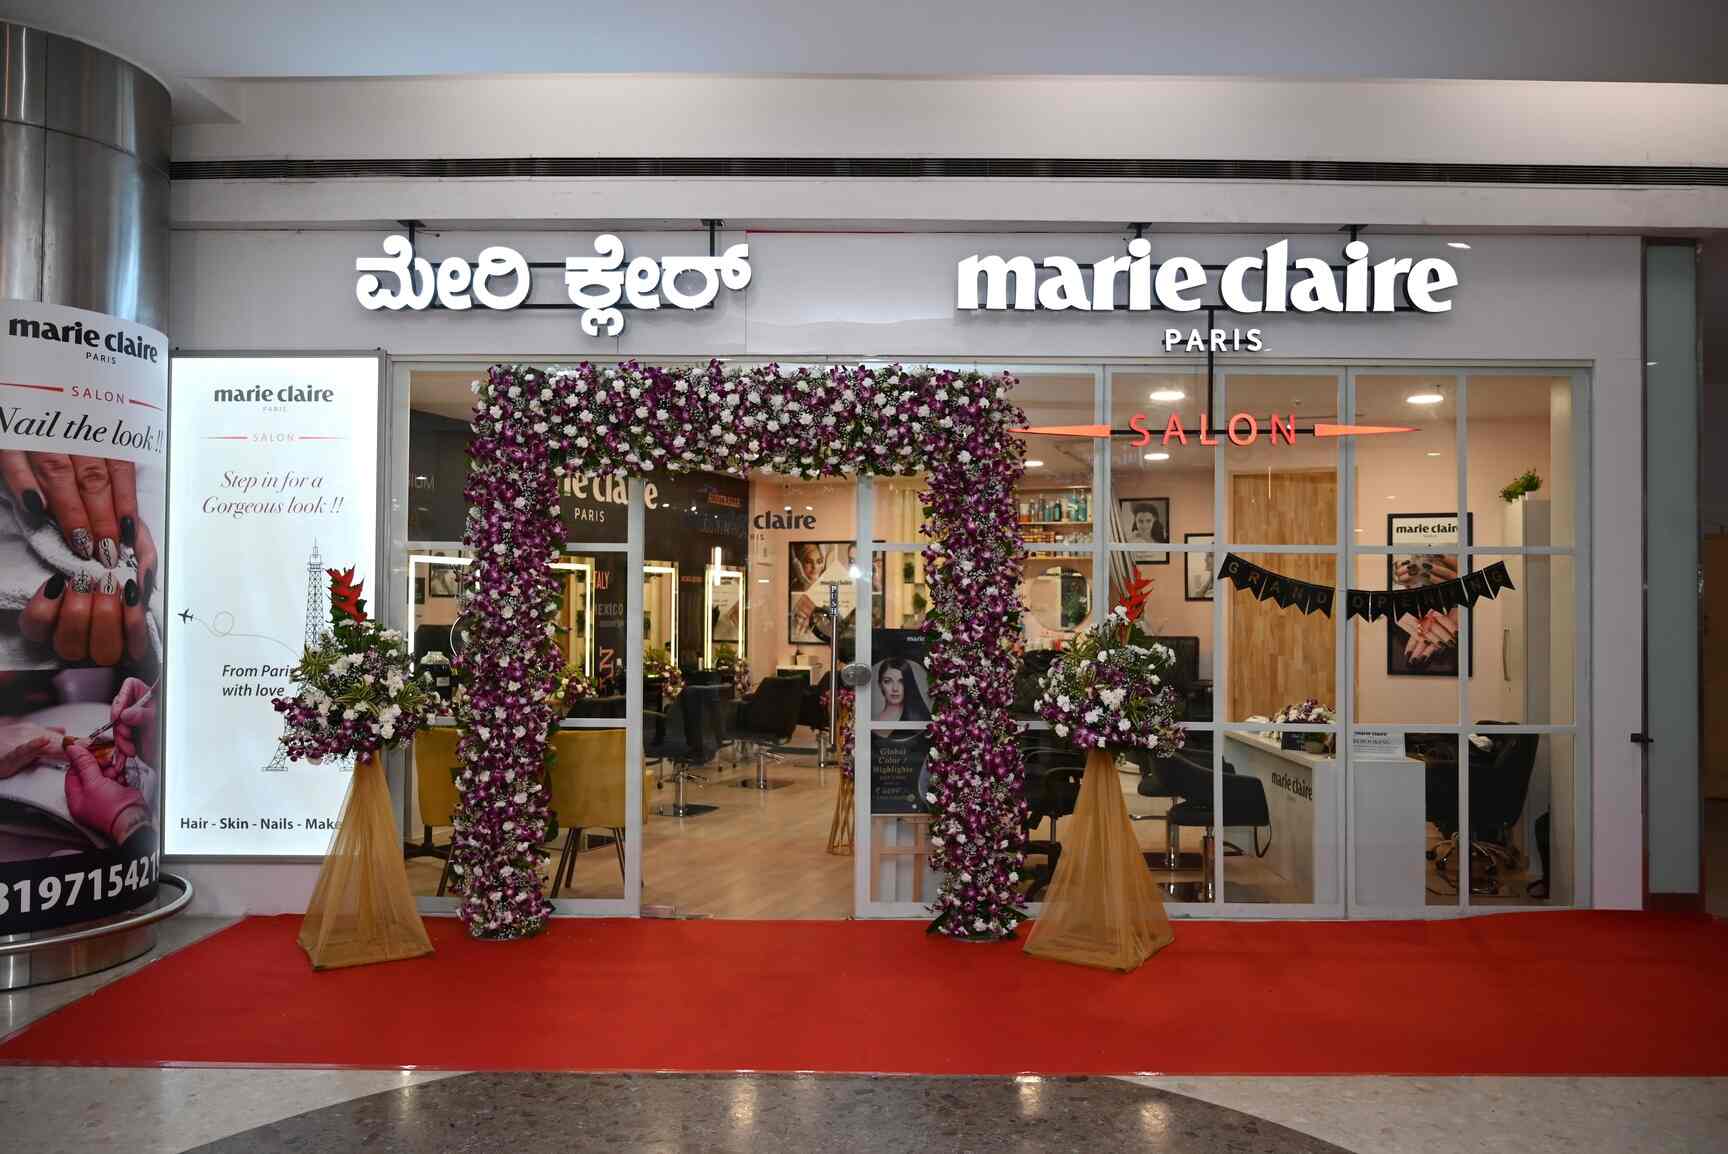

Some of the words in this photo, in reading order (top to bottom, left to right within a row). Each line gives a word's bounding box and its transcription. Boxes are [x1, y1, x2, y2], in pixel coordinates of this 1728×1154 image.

[356, 235, 530, 310] ಮೇರಿ
[565, 234, 752, 336] ಕ್ಲೇರ್
[958, 238, 1207, 312] marie
[1221, 239, 1459, 313] claire
[9, 318, 100, 347] marie
[105, 331, 158, 363] claire
[1165, 328, 1263, 352] PARIS
[86, 352, 117, 364] PARIS
[72, 386, 125, 404] SALON
[214, 385, 273, 402] marie
[277, 385, 335, 402] claire
[0, 406, 61, 438] Nail
[63, 414, 107, 443] the
[1129, 413, 1297, 447] SALON
[252, 432, 296, 442] SALON
[221, 470, 258, 493] Step
[261, 471, 278, 488] in
[275, 470, 309, 493] for
[311, 476, 324, 488] a
[592, 474, 658, 509] clae
[202, 496, 283, 519] Gorgeous
[287, 496, 327, 513] look
[574, 508, 605, 523] PARIS
[753, 510, 816, 529] claire
[1396, 523, 1430, 533] marie
[1431, 523, 1458, 533] clair
[598, 602, 624, 616] EXICO
[222, 664, 258, 677] From
[261, 664, 290, 677] Pari
[222, 683, 252, 696] with
[255, 683, 285, 696] love
[1271, 771, 1292, 791] marie
[180, 817, 209, 830] Hair
[219, 817, 249, 830] Skin
[260, 817, 294, 830] Nails
[305, 817, 338, 830] Mak
